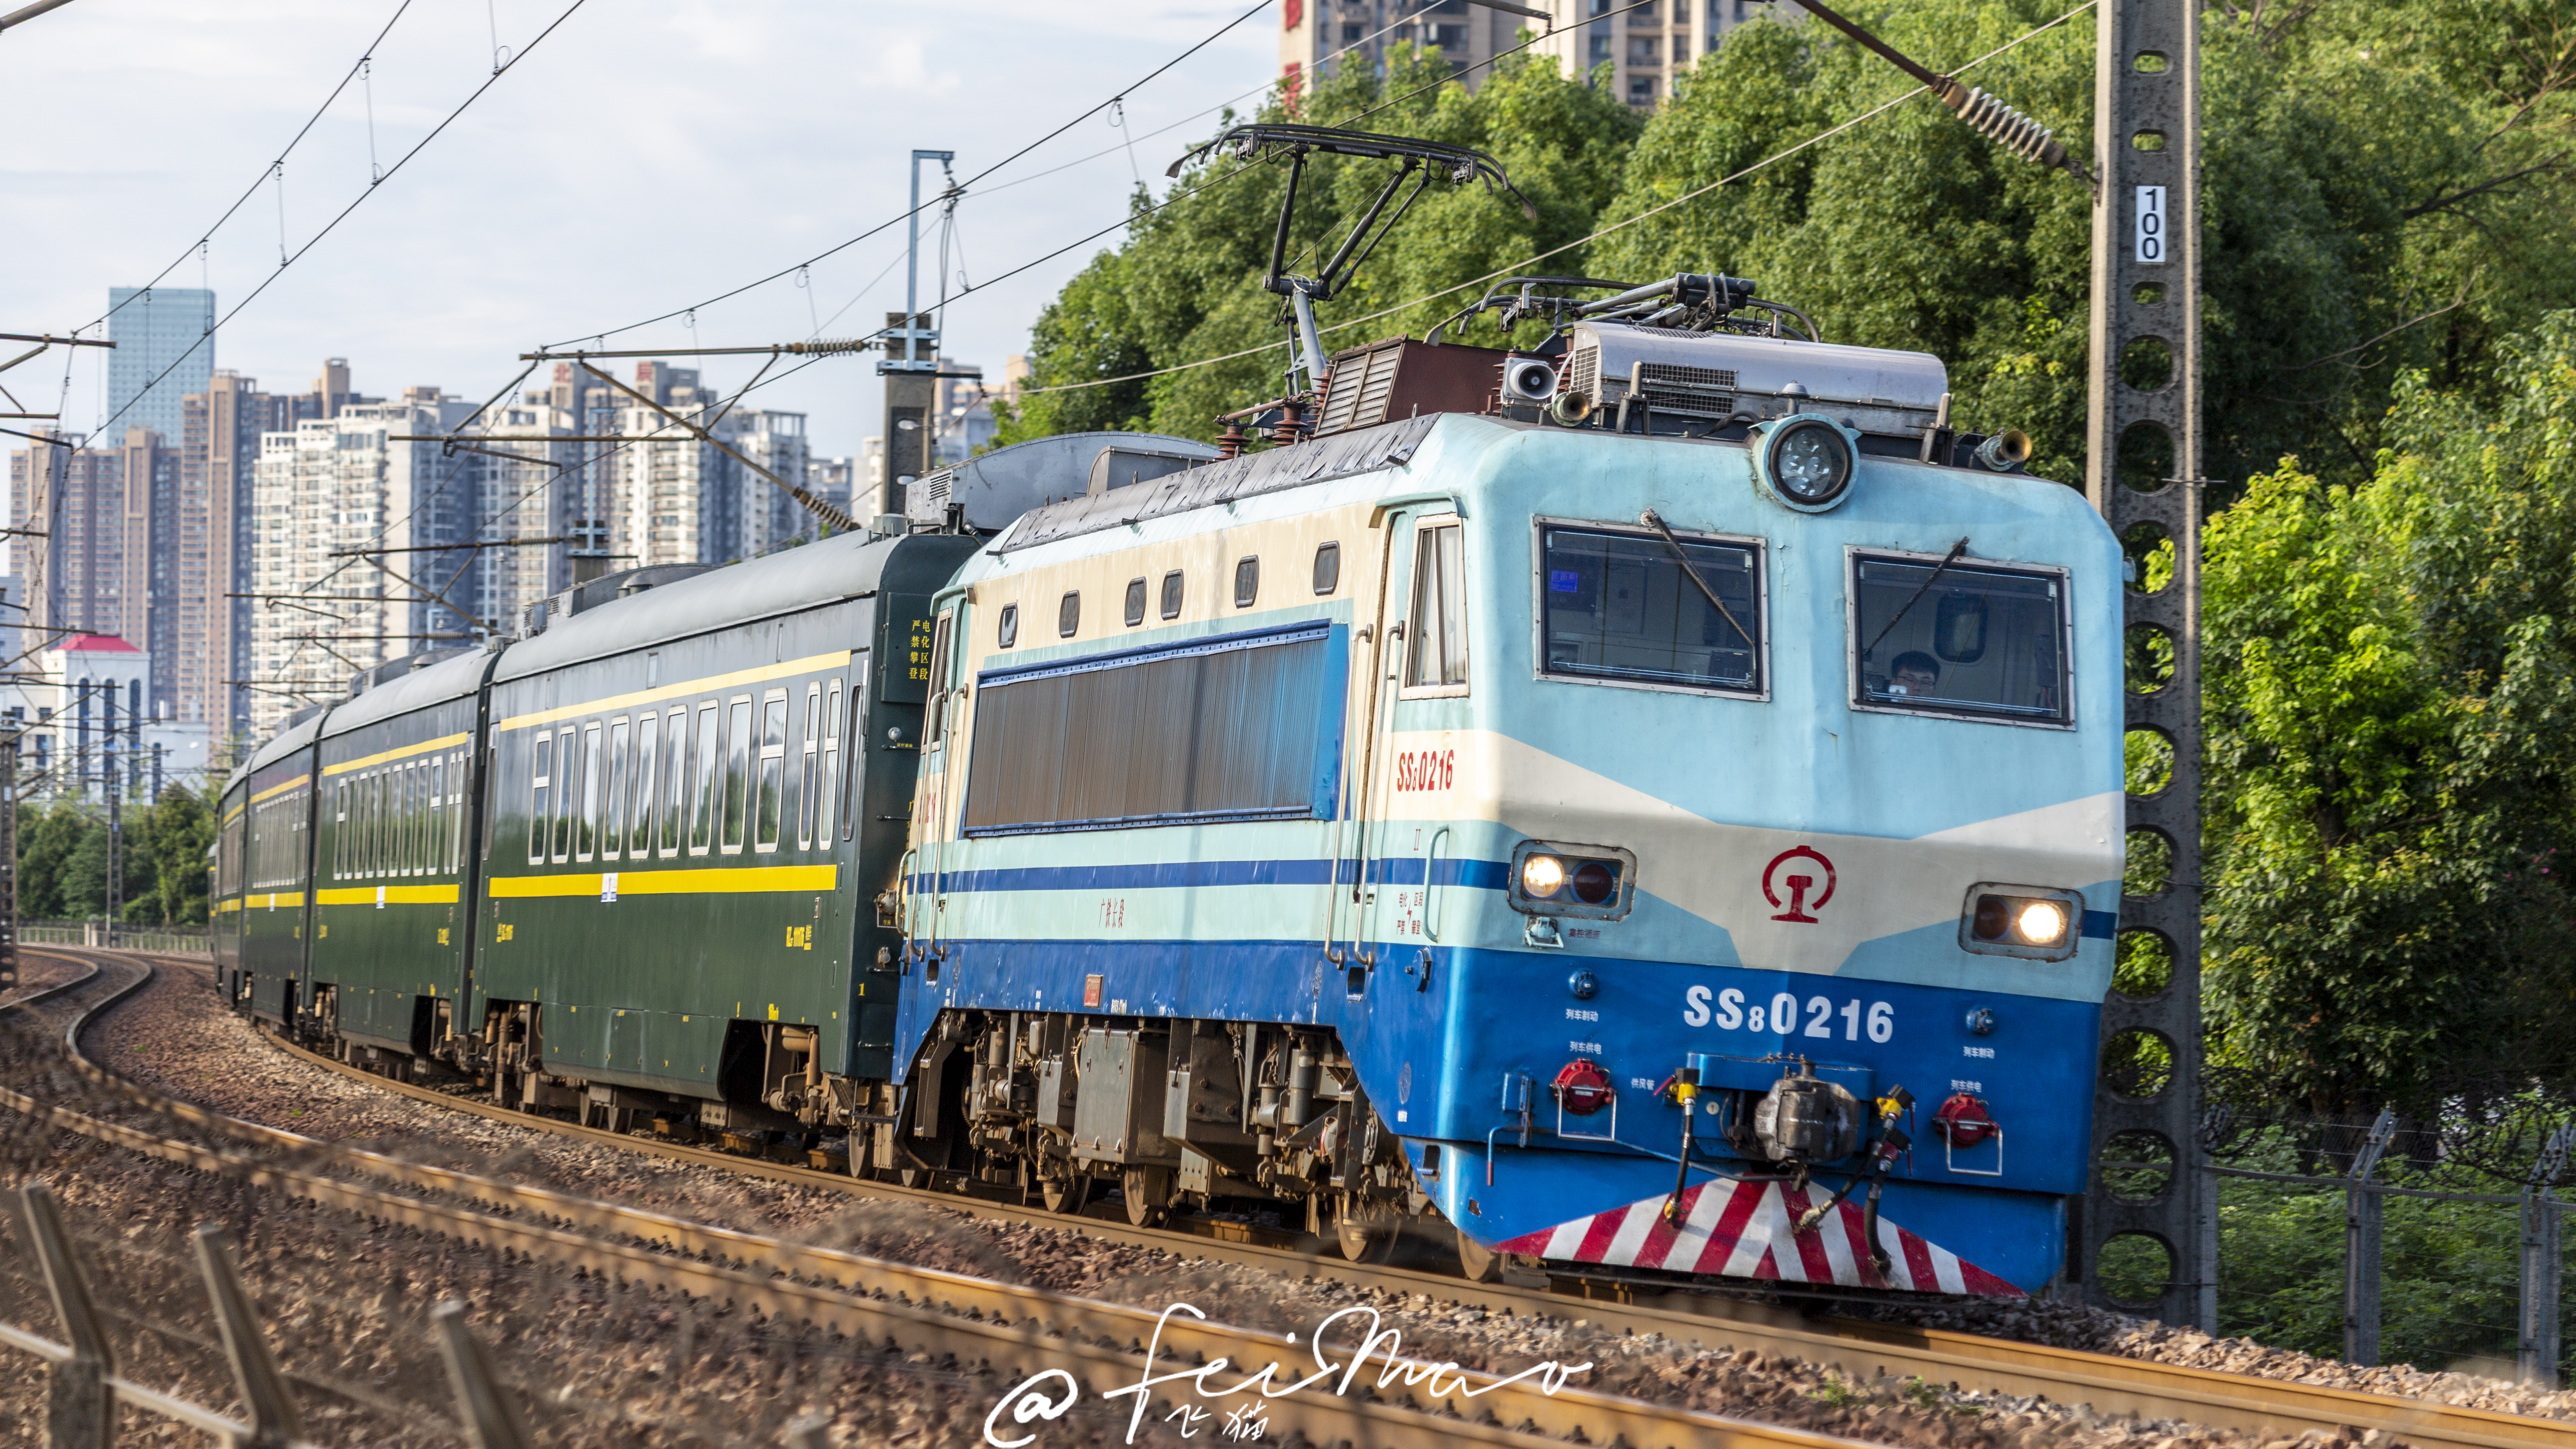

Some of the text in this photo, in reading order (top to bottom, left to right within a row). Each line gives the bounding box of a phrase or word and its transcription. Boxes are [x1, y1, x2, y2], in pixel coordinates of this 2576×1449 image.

[2143, 188, 2159, 259] 100
[909, 619, 921, 679] 严禁攀登
[919, 620, 931, 680] 电化区段
[858, 983, 865, 996] 1
[1566, 1008, 1599, 1022] 列车制动
[1683, 985, 1895, 1044] SS80216
[1569, 1041, 1602, 1055] 列车供电
[1963, 1046, 1996, 1059] 列车制动
[1631, 1078, 1655, 1091] 供风管
